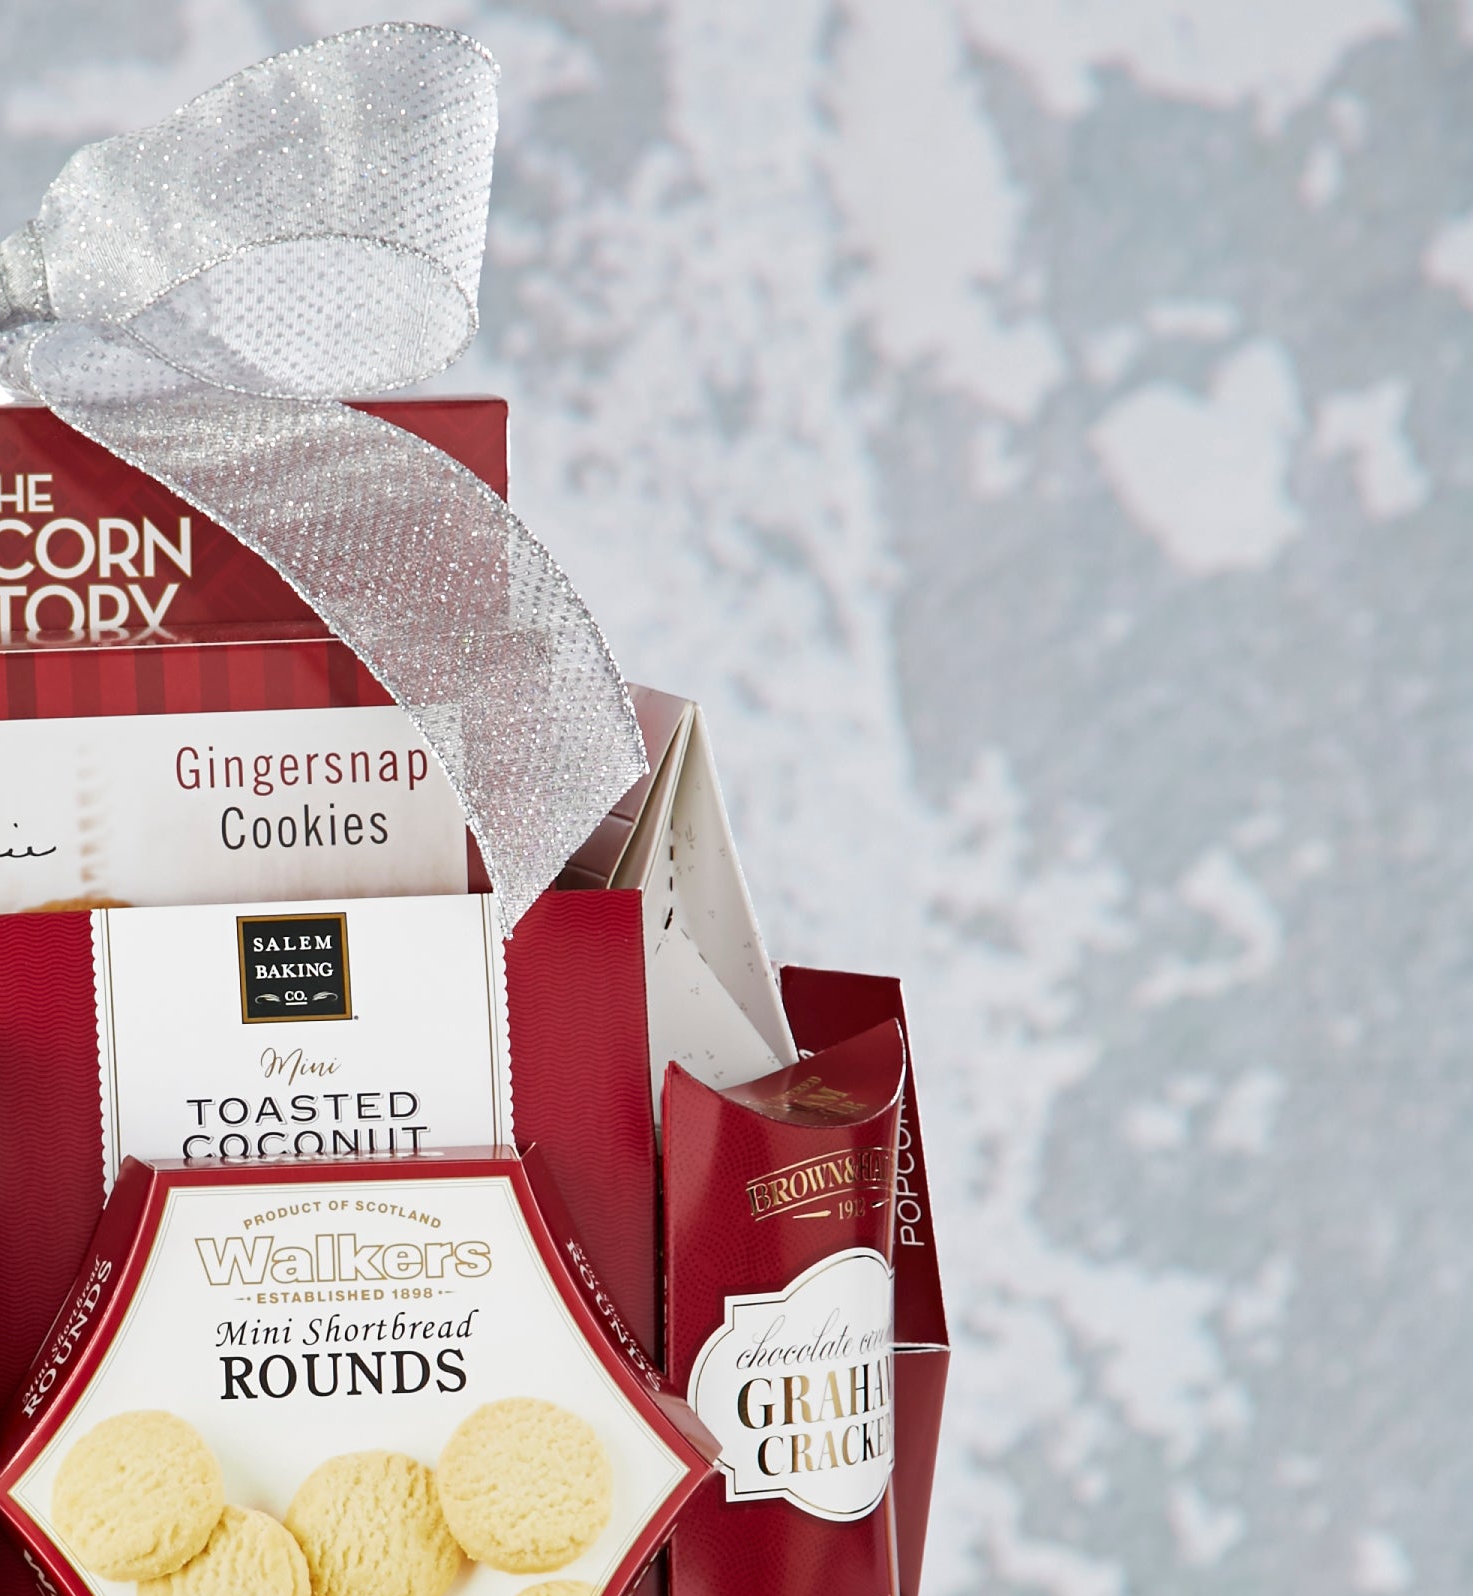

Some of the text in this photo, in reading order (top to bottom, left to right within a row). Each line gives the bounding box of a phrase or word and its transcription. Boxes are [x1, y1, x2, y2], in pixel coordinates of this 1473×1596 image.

[176, 746, 429, 796] Gingersnap
[221, 803, 389, 850] Cookies
[253, 935, 333, 952] SALEM
[255, 962, 334, 979] BAKING
[284, 990, 308, 1002] CO.
[260, 1047, 342, 1086] Mini
[186, 1091, 421, 1127] TOASTED
[181, 1126, 430, 1160] COCONUT
[894, 1092, 925, 1246] POPCO
[243, 1200, 442, 1230] PRODUCT OF SCOTLAND
[194, 1233, 493, 1286] Walkers
[257, 1287, 433, 1304] ESTABLISHED 1898
[565, 1237, 662, 1392] ROUNDS
[22, 1260, 113, 1418] ROUNDS
[215, 1309, 480, 1347] Mini Shortbread
[735, 1307, 853, 1369] chocolate
[219, 1349, 467, 1400] ROUNDS
